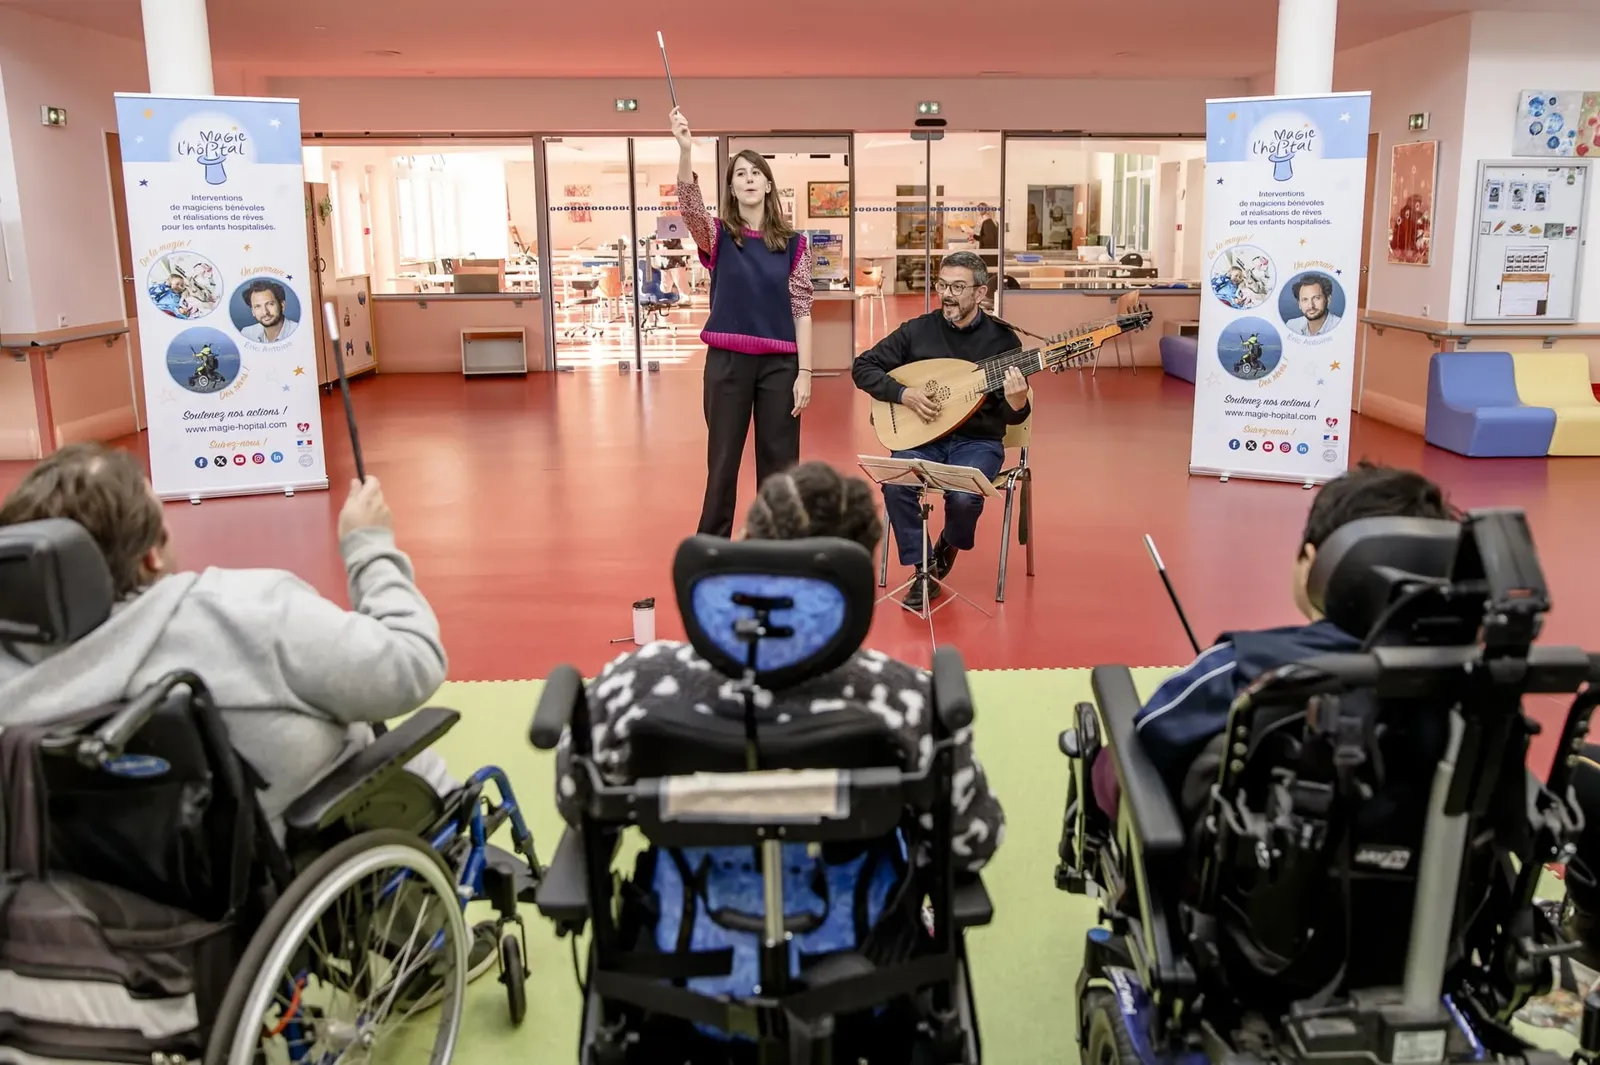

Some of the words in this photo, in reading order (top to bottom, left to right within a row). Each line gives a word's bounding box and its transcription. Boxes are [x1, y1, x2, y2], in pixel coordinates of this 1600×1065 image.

[182, 204, 223, 212] magiciens
[1224, 394, 1261, 408] Soutenez
[1280, 399, 1311, 408] actions
[182, 410, 225, 422] Soutenez
[227, 410, 244, 418] nos
[246, 407, 280, 417] actions
[1224, 410, 1317, 420] www.magie-hopital.com
[185, 421, 287, 433] www.magie-hopital.com
